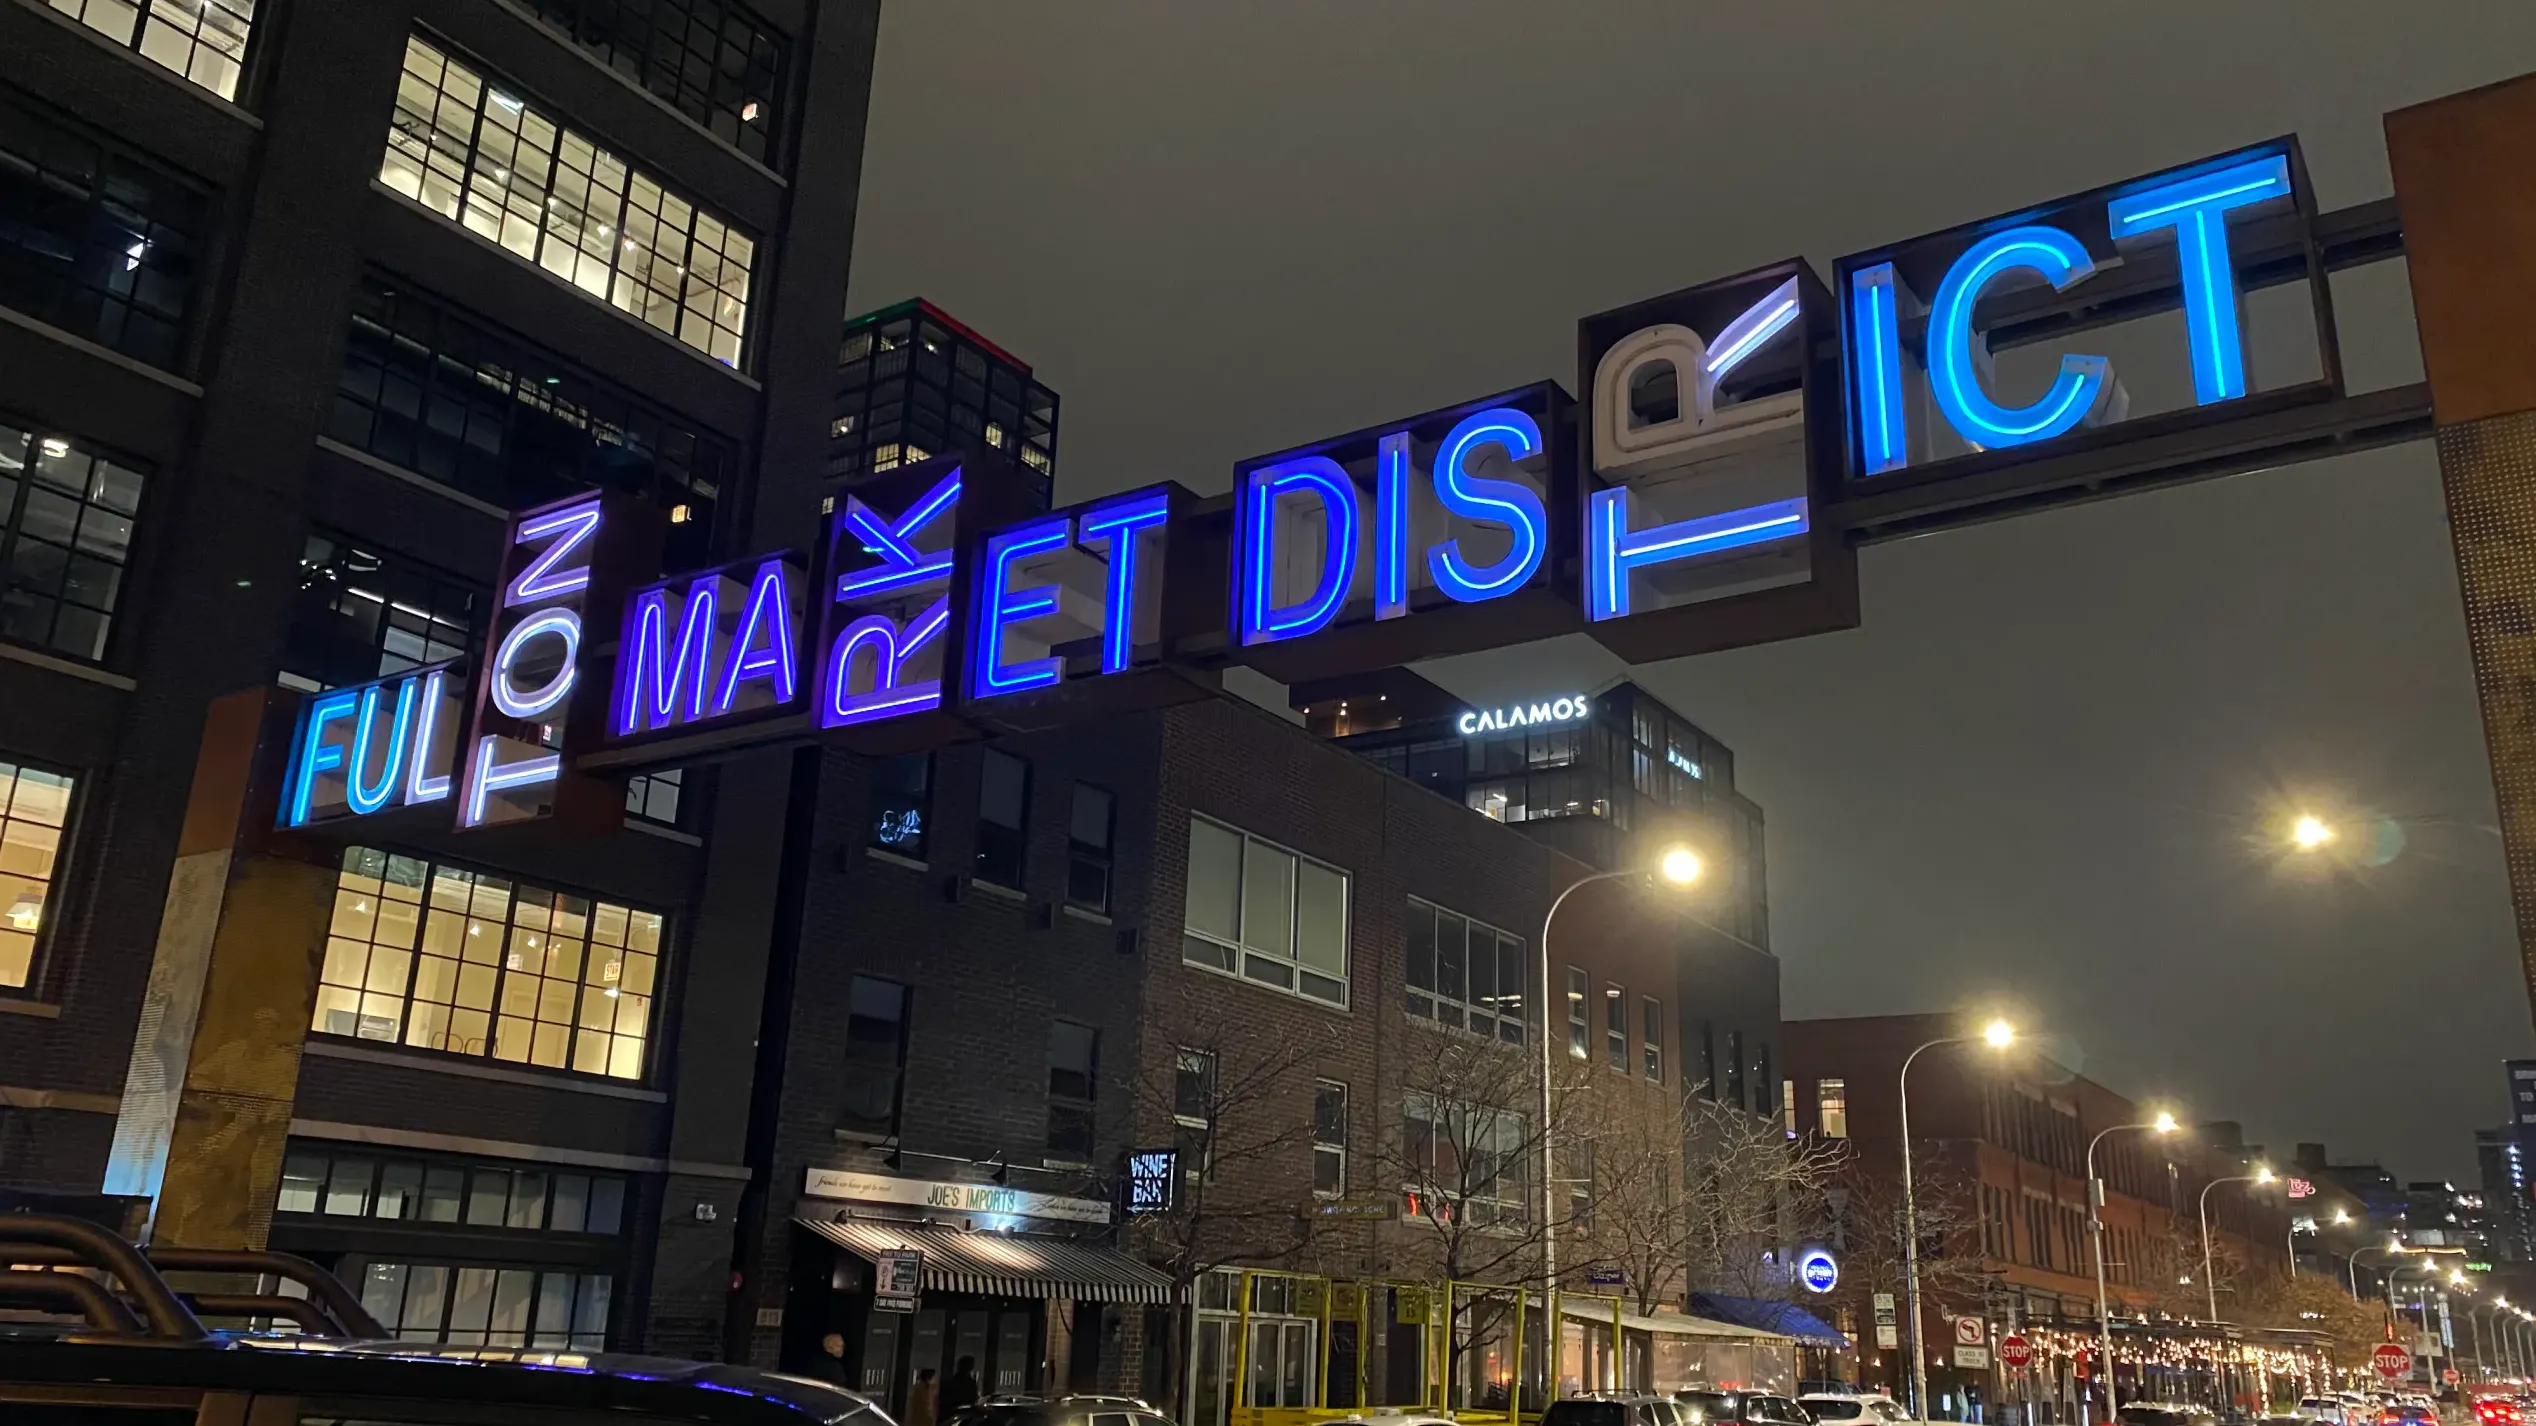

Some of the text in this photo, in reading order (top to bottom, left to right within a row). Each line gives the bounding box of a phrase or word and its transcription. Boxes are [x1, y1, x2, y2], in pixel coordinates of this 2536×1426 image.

[1459, 695, 1587, 734] CALAMOS
[1130, 1154, 1168, 1178] WINE
[927, 1184, 1015, 1212] JOE'S IMPORTS
[1133, 1179, 1162, 1203] BAR
[2003, 1345, 2030, 1358] STOP
[2375, 1354, 2408, 1369] STOP
